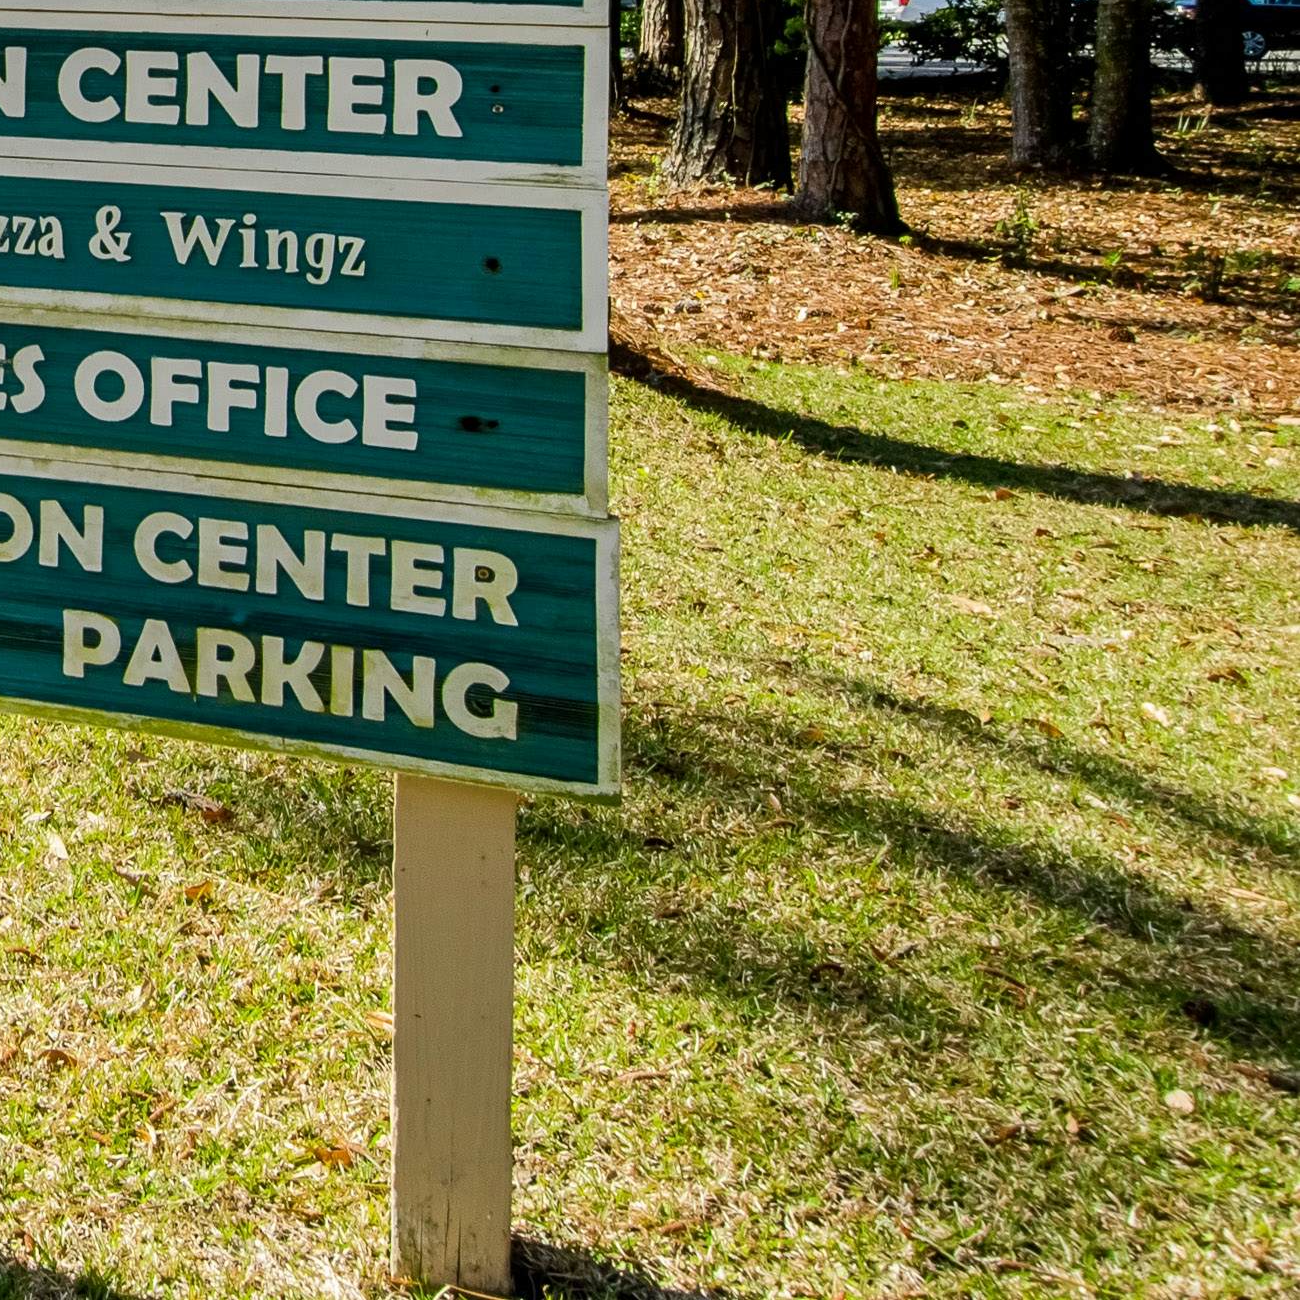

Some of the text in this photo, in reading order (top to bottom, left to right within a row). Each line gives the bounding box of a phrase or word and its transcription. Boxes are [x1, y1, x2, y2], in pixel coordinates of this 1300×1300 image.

[58, 48, 462, 137] CENTER
[89, 206, 131, 261] &
[160, 212, 365, 284] Wingz
[74, 351, 418, 450] OFFICE
[134, 512, 518, 626] CENTER
[63, 609, 518, 740] PARKING
